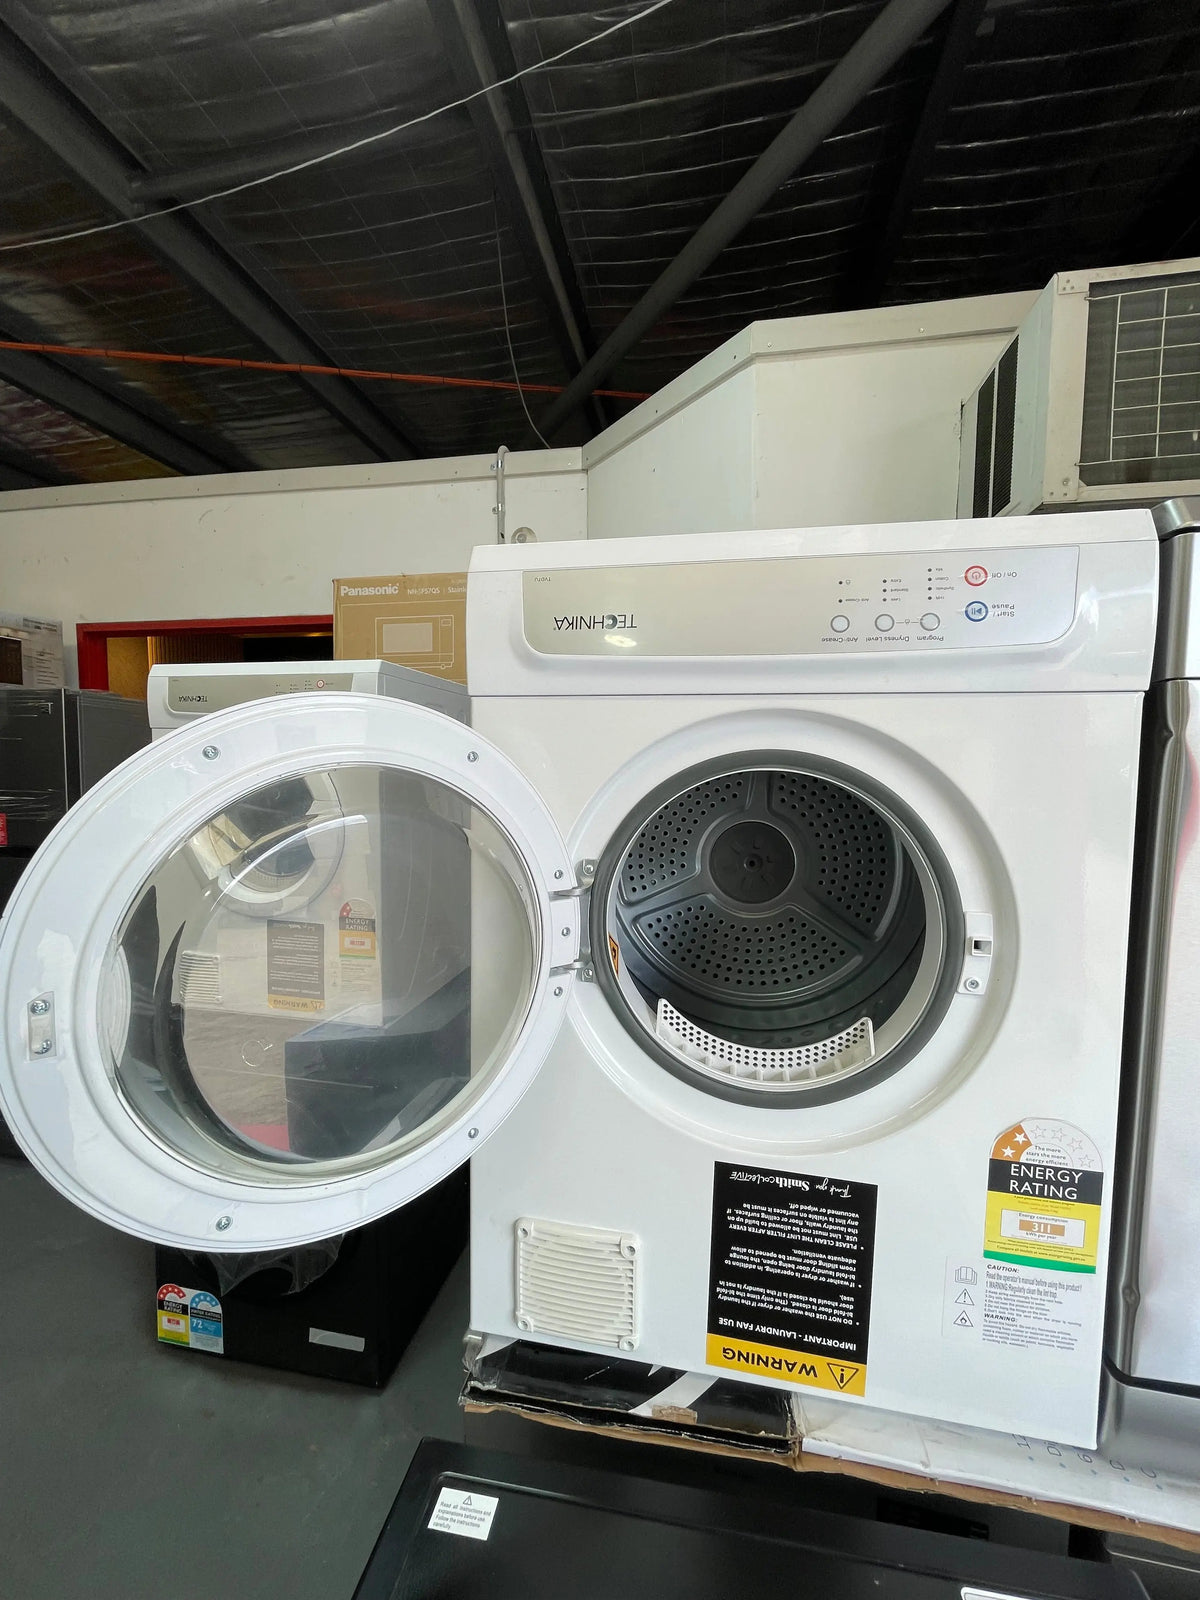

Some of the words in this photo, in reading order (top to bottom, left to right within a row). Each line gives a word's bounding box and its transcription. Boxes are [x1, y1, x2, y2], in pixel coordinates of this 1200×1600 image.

[340, 583, 399, 596] Panasonic
[553, 614, 638, 631] TECHNIKA
[884, 635, 910, 643] Dryness
[916, 634, 944, 642] Program
[178, 695, 207, 703] TECHNIKA
[1010, 1163, 1083, 1184] ENERGY
[1008, 1179, 1078, 1200] RATING
[773, 1207, 798, 1216] surfaces
[799, 1204, 818, 1212] wiped
[760, 1212, 780, 1220] ceiling
[807, 1213, 828, 1221] visible
[826, 1208, 859, 1218] vacuumed
[744, 1218, 759, 1226] build
[767, 1222, 791, 1230] allowed
[728, 1223, 746, 1231] EVERY
[747, 1226, 765, 1234] AFTER
[822, 1222, 846, 1232] laundry
[1031, 1222, 1051, 1234] 311
[766, 1229, 785, 1237] FILTER
[786, 1232, 800, 1240] LINT
[814, 1237, 834, 1245] CLEAN
[834, 1240, 857, 1249] PLEASE
[730, 1245, 747, 1253] allow
[754, 1249, 777, 1257] opened
[729, 1252, 749, 1261] lounge
[827, 1254, 856, 1264] adequate
[731, 1260, 756, 1269] addition
[778, 1260, 795, 1269] being
[795, 1264, 810, 1272] door
[817, 1259, 838, 1269] sliding
[986, 1263, 1019, 1273] CAUTION:
[810, 1266, 834, 1276] laundry
[826, 1277, 849, 1285] washer
[742, 1283, 765, 1293] laundry
[717, 1293, 740, 1303] laundry
[788, 1293, 808, 1301] closed
[817, 1298, 839, 1307] should
[838, 1302, 853, 1310] door
[781, 1306, 803, 1314] washer
[815, 1312, 827, 1320] USE
[827, 1315, 842, 1323] NOT
[983, 1312, 1018, 1323] WARNING:
[191, 1319, 202, 1329] 72
[718, 1317, 734, 1326] USE
[736, 1320, 753, 1330] FAN
[754, 1324, 796, 1339] LAUNDRY
[802, 1334, 856, 1350] IMPORTANT
[722, 1347, 817, 1377] WARNING
